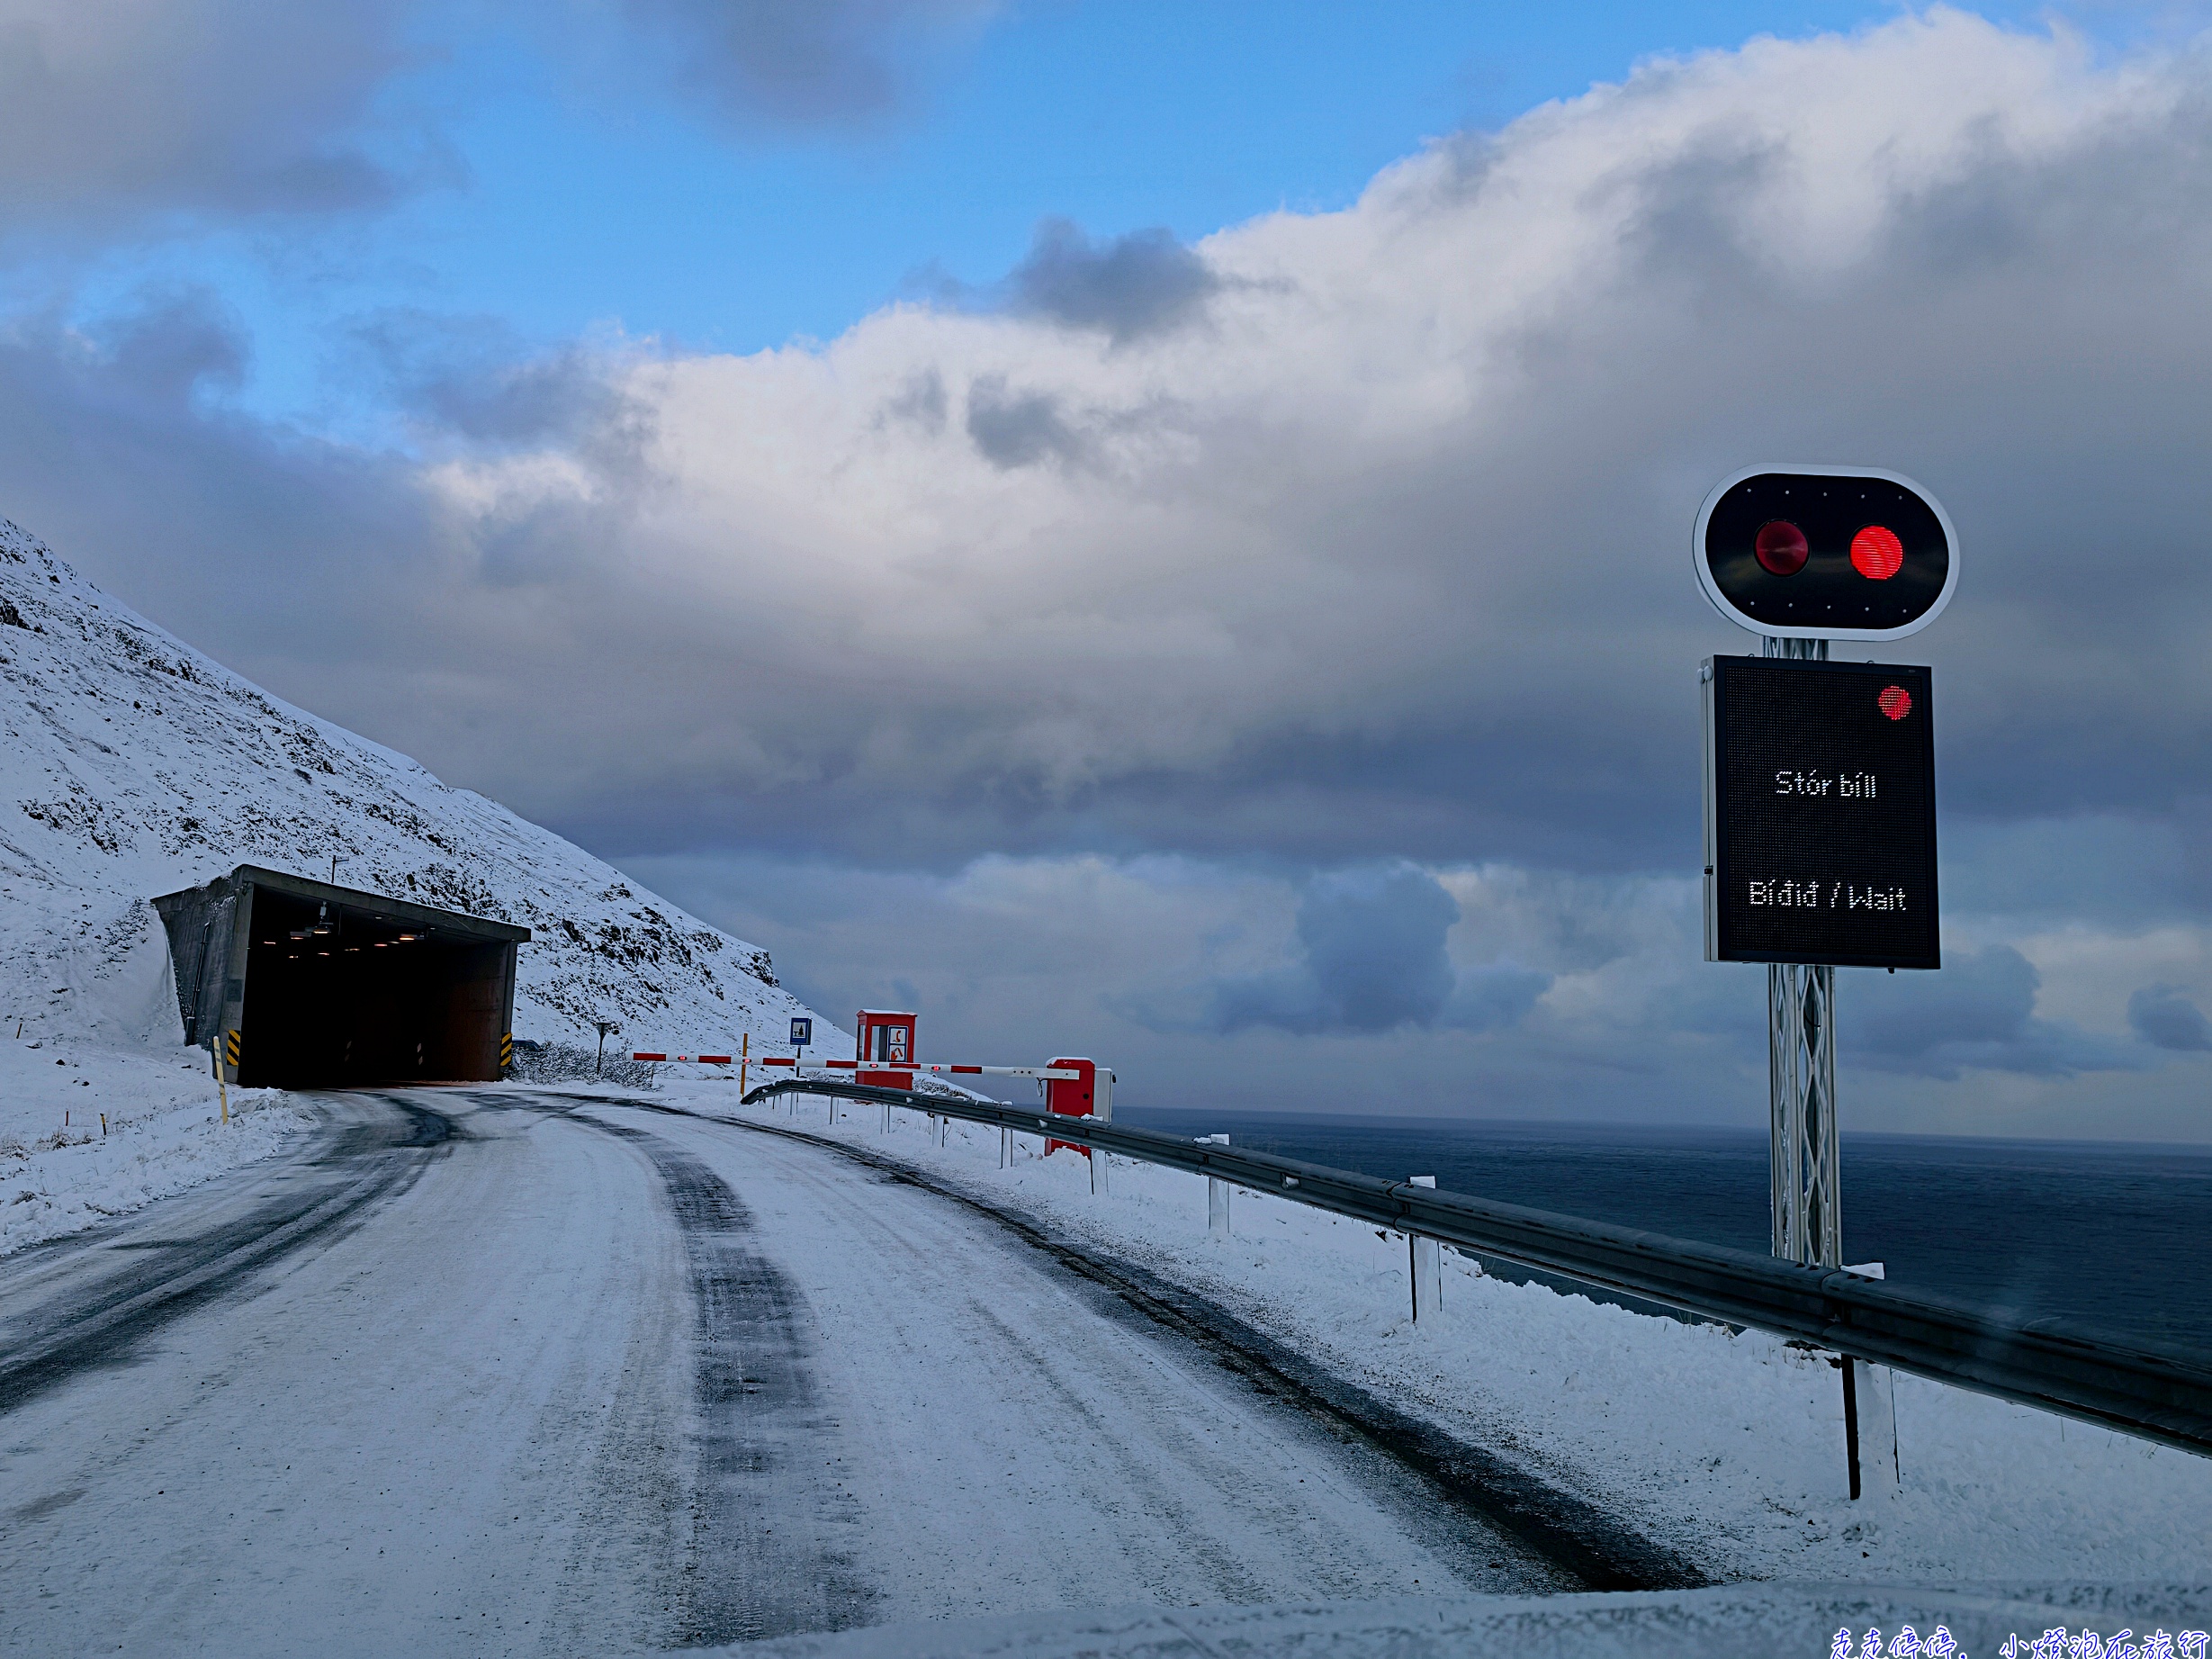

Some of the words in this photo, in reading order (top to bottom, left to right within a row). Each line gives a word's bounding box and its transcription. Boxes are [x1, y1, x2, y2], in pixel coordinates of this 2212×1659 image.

[1776, 768, 1833, 796] Stór
[1839, 771, 1877, 798] bíll
[1749, 879, 1820, 907] Bíðið
[1830, 881, 1842, 908] /
[1848, 886, 1907, 911] Wait
